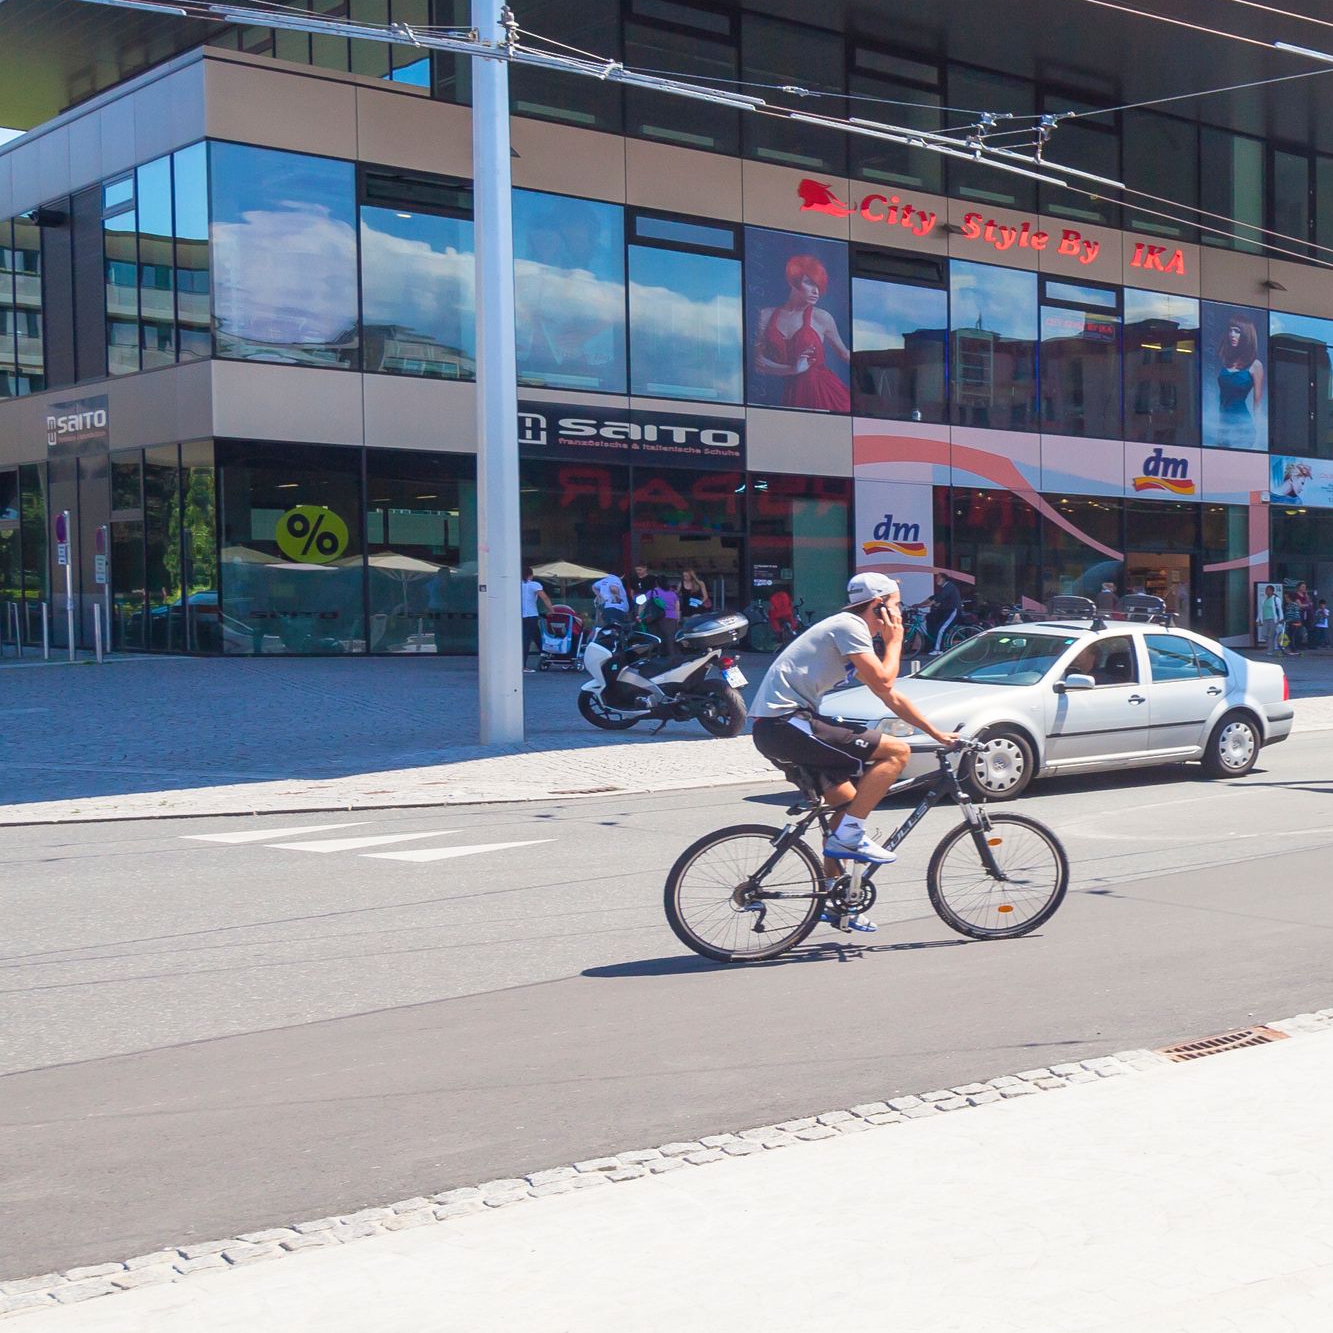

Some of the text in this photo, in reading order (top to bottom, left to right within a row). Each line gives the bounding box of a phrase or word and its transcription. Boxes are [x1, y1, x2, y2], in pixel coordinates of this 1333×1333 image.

[860, 193, 1186, 276] City Style By IKA
[631, 442, 640, 451] &
[1142, 448, 1188, 479] dm
[873, 514, 921, 543] dm
